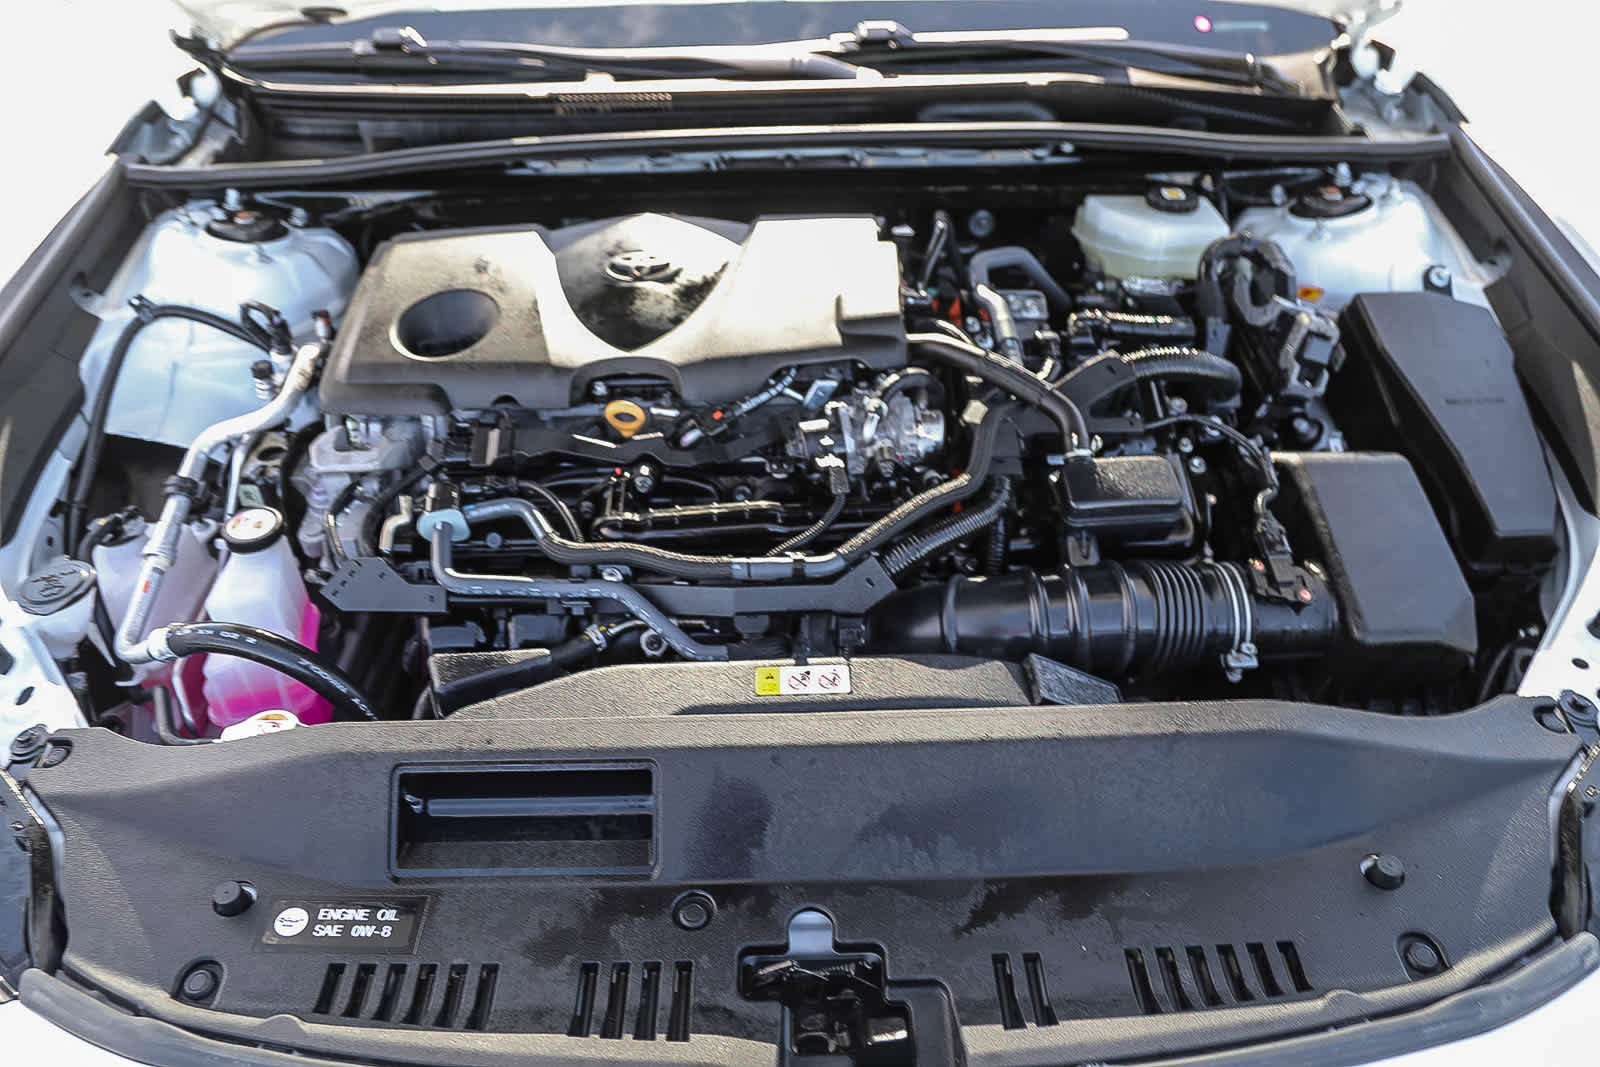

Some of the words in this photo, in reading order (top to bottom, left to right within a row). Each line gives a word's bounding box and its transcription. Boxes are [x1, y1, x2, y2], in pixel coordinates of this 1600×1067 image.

[317, 908, 371, 921] ENGINE
[376, 909, 400, 921] OIL
[312, 924, 345, 937] SAE
[350, 925, 393, 938] 0W-8
